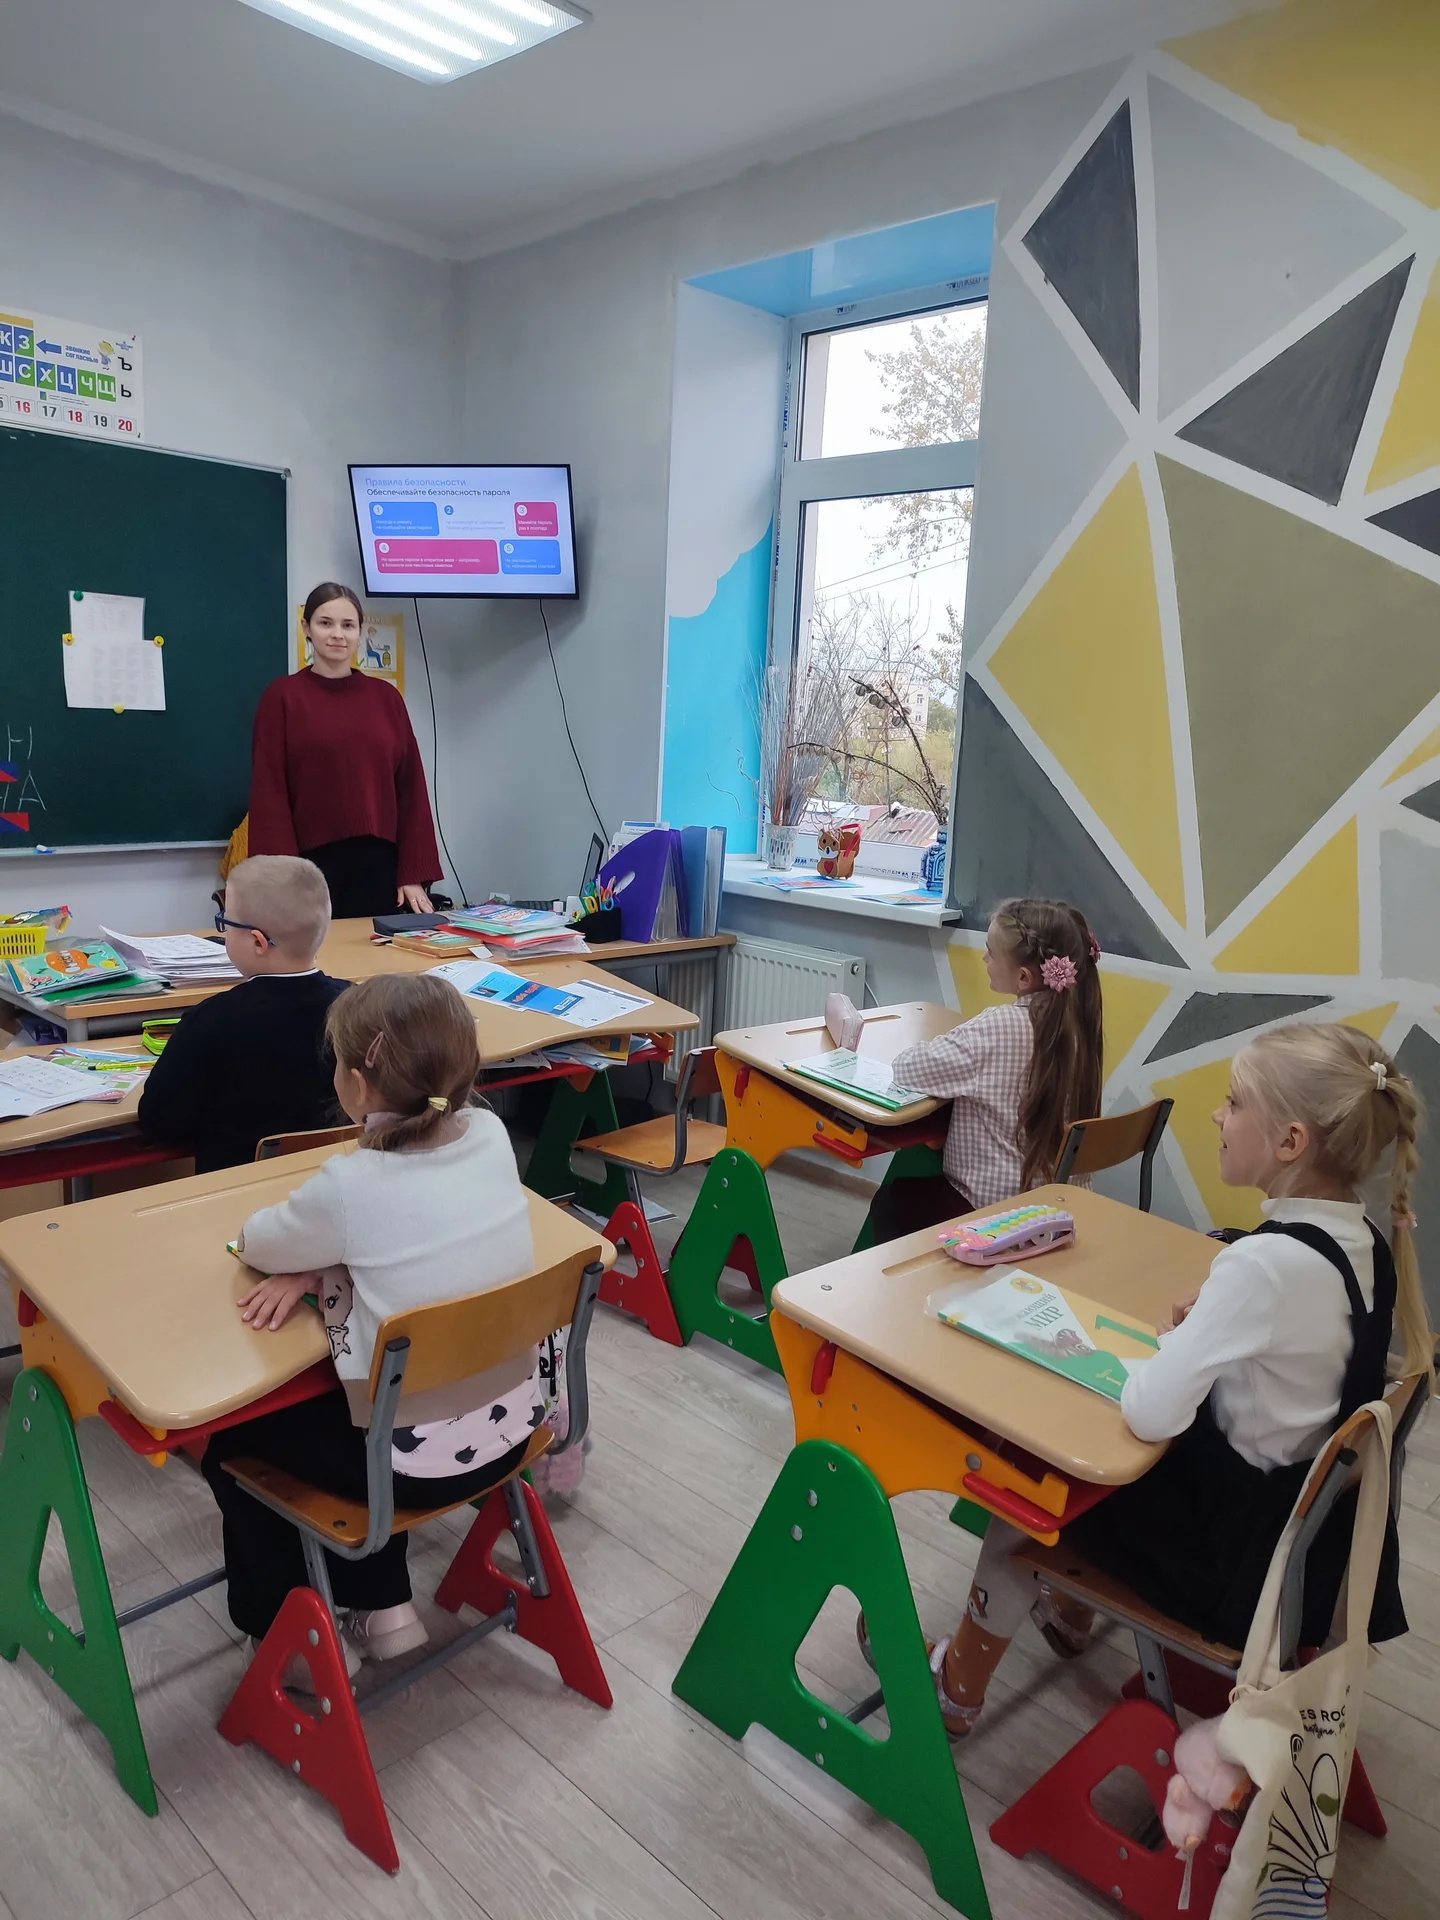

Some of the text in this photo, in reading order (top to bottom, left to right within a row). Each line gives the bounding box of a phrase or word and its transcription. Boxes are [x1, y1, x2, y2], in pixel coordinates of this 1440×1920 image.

[15, 400, 31, 413] 16
[42, 405, 57, 418] 17
[68, 410, 83, 423] 18
[93, 414, 108, 427] 19
[118, 419, 132, 432] 20
[365, 478, 466, 487] Правила безопасности
[366, 488, 511, 497] Обеспечивайте безопасность пароля
[1024, 1306, 1064, 1331] МИР
